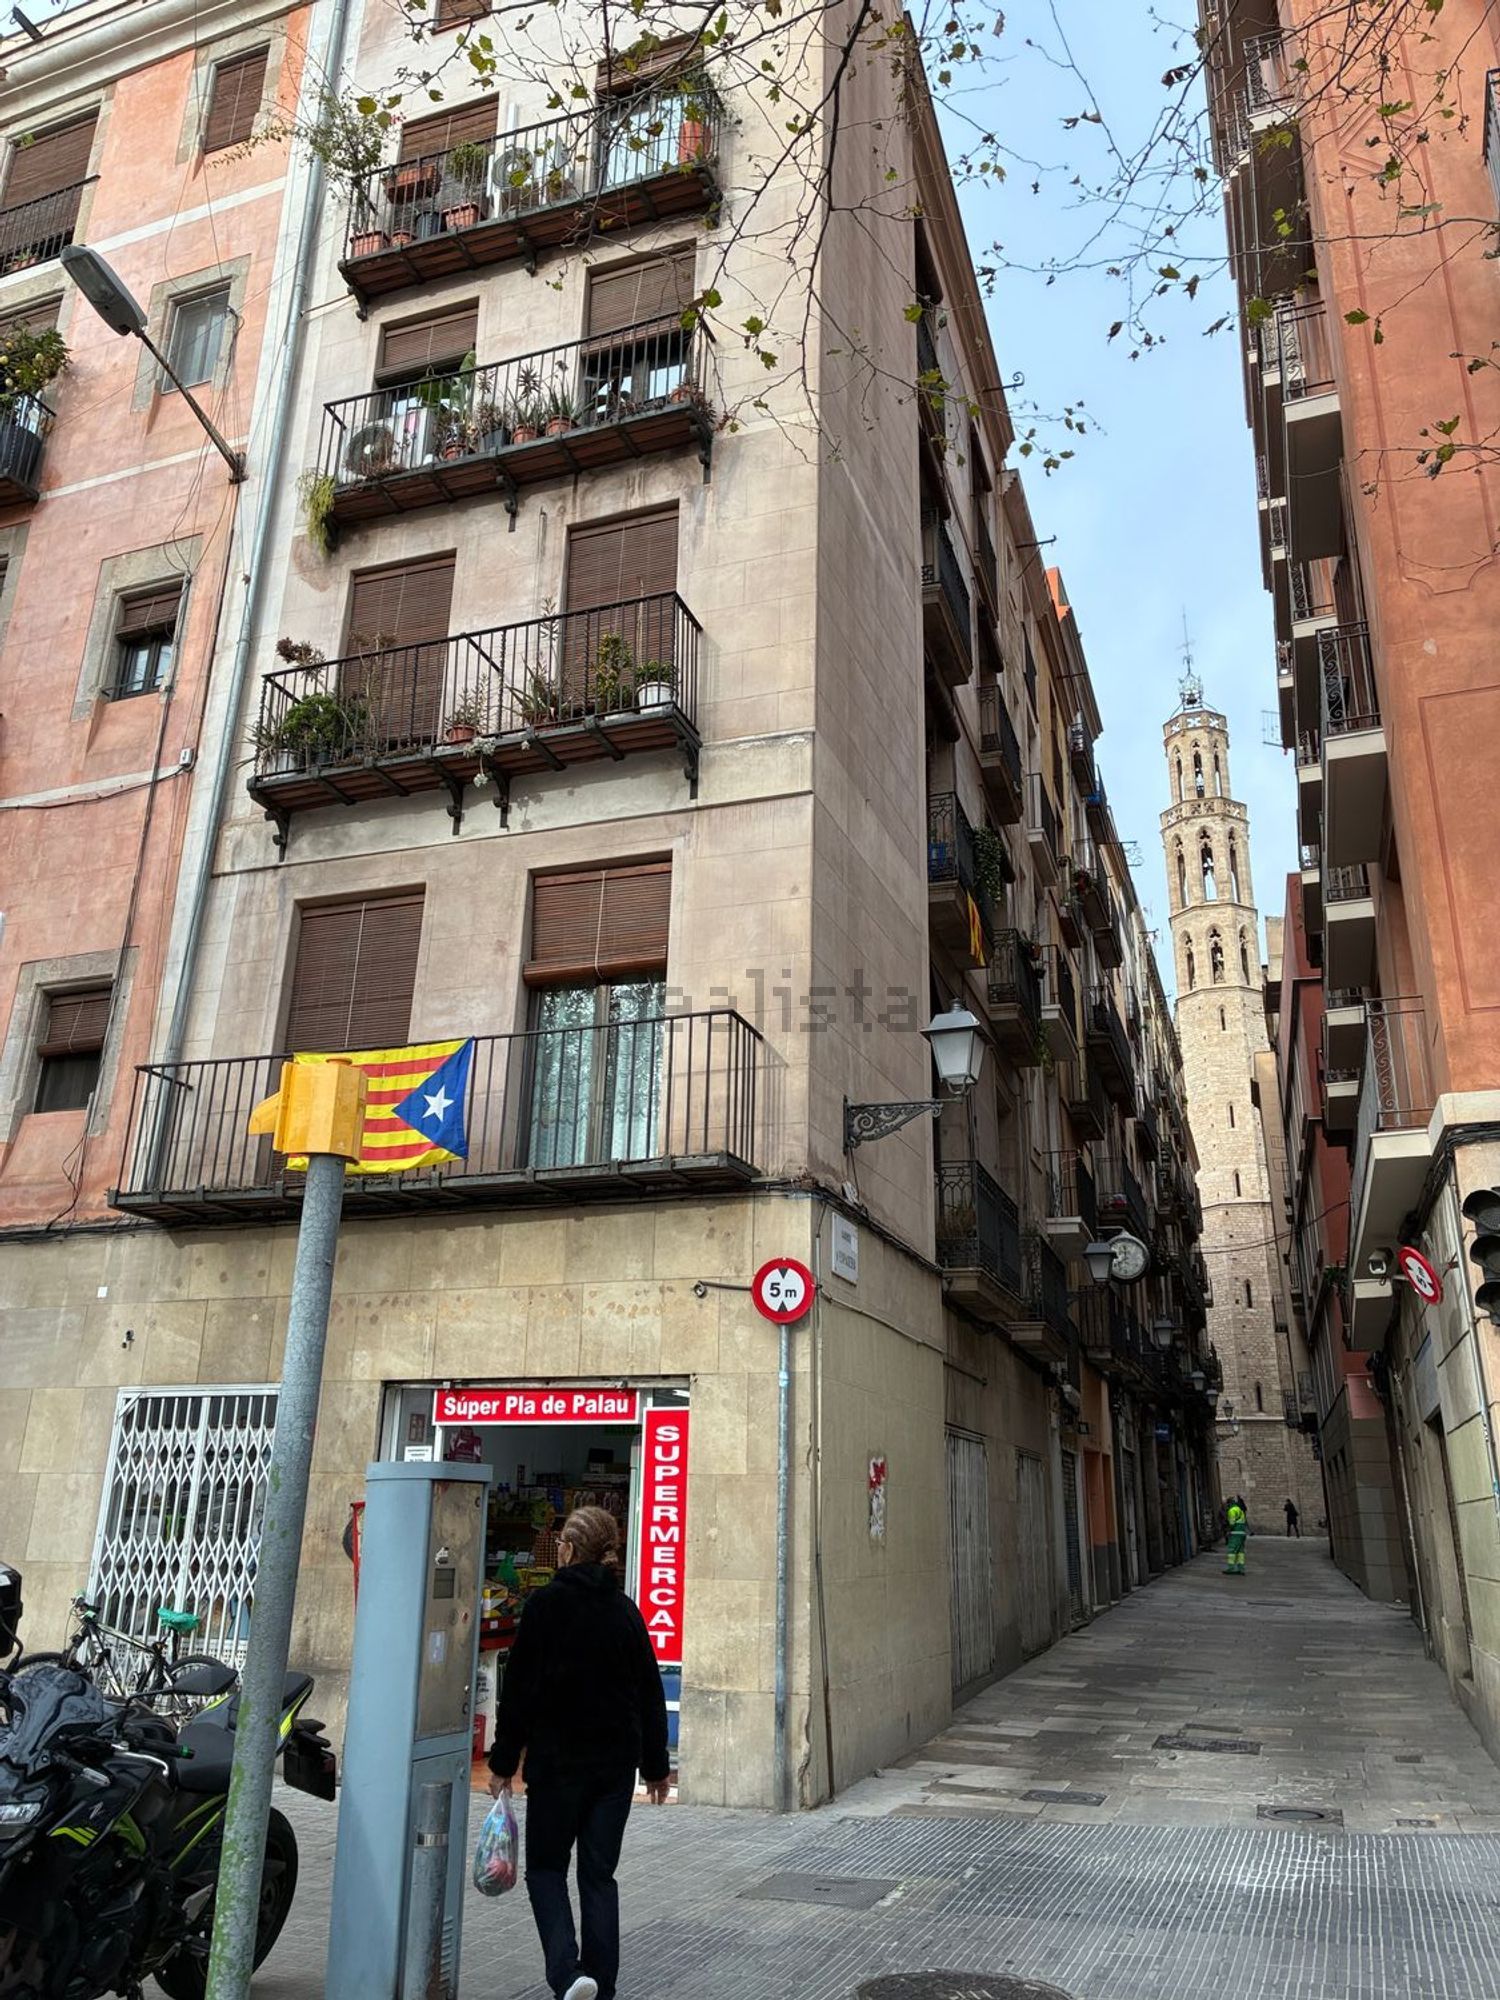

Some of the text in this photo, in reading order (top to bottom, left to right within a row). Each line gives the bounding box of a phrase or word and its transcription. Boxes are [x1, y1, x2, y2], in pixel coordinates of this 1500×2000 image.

[444, 1394, 629, 1420] Súper Pla de Palau
[649, 1425, 680, 1649] SUPERMERCAT
